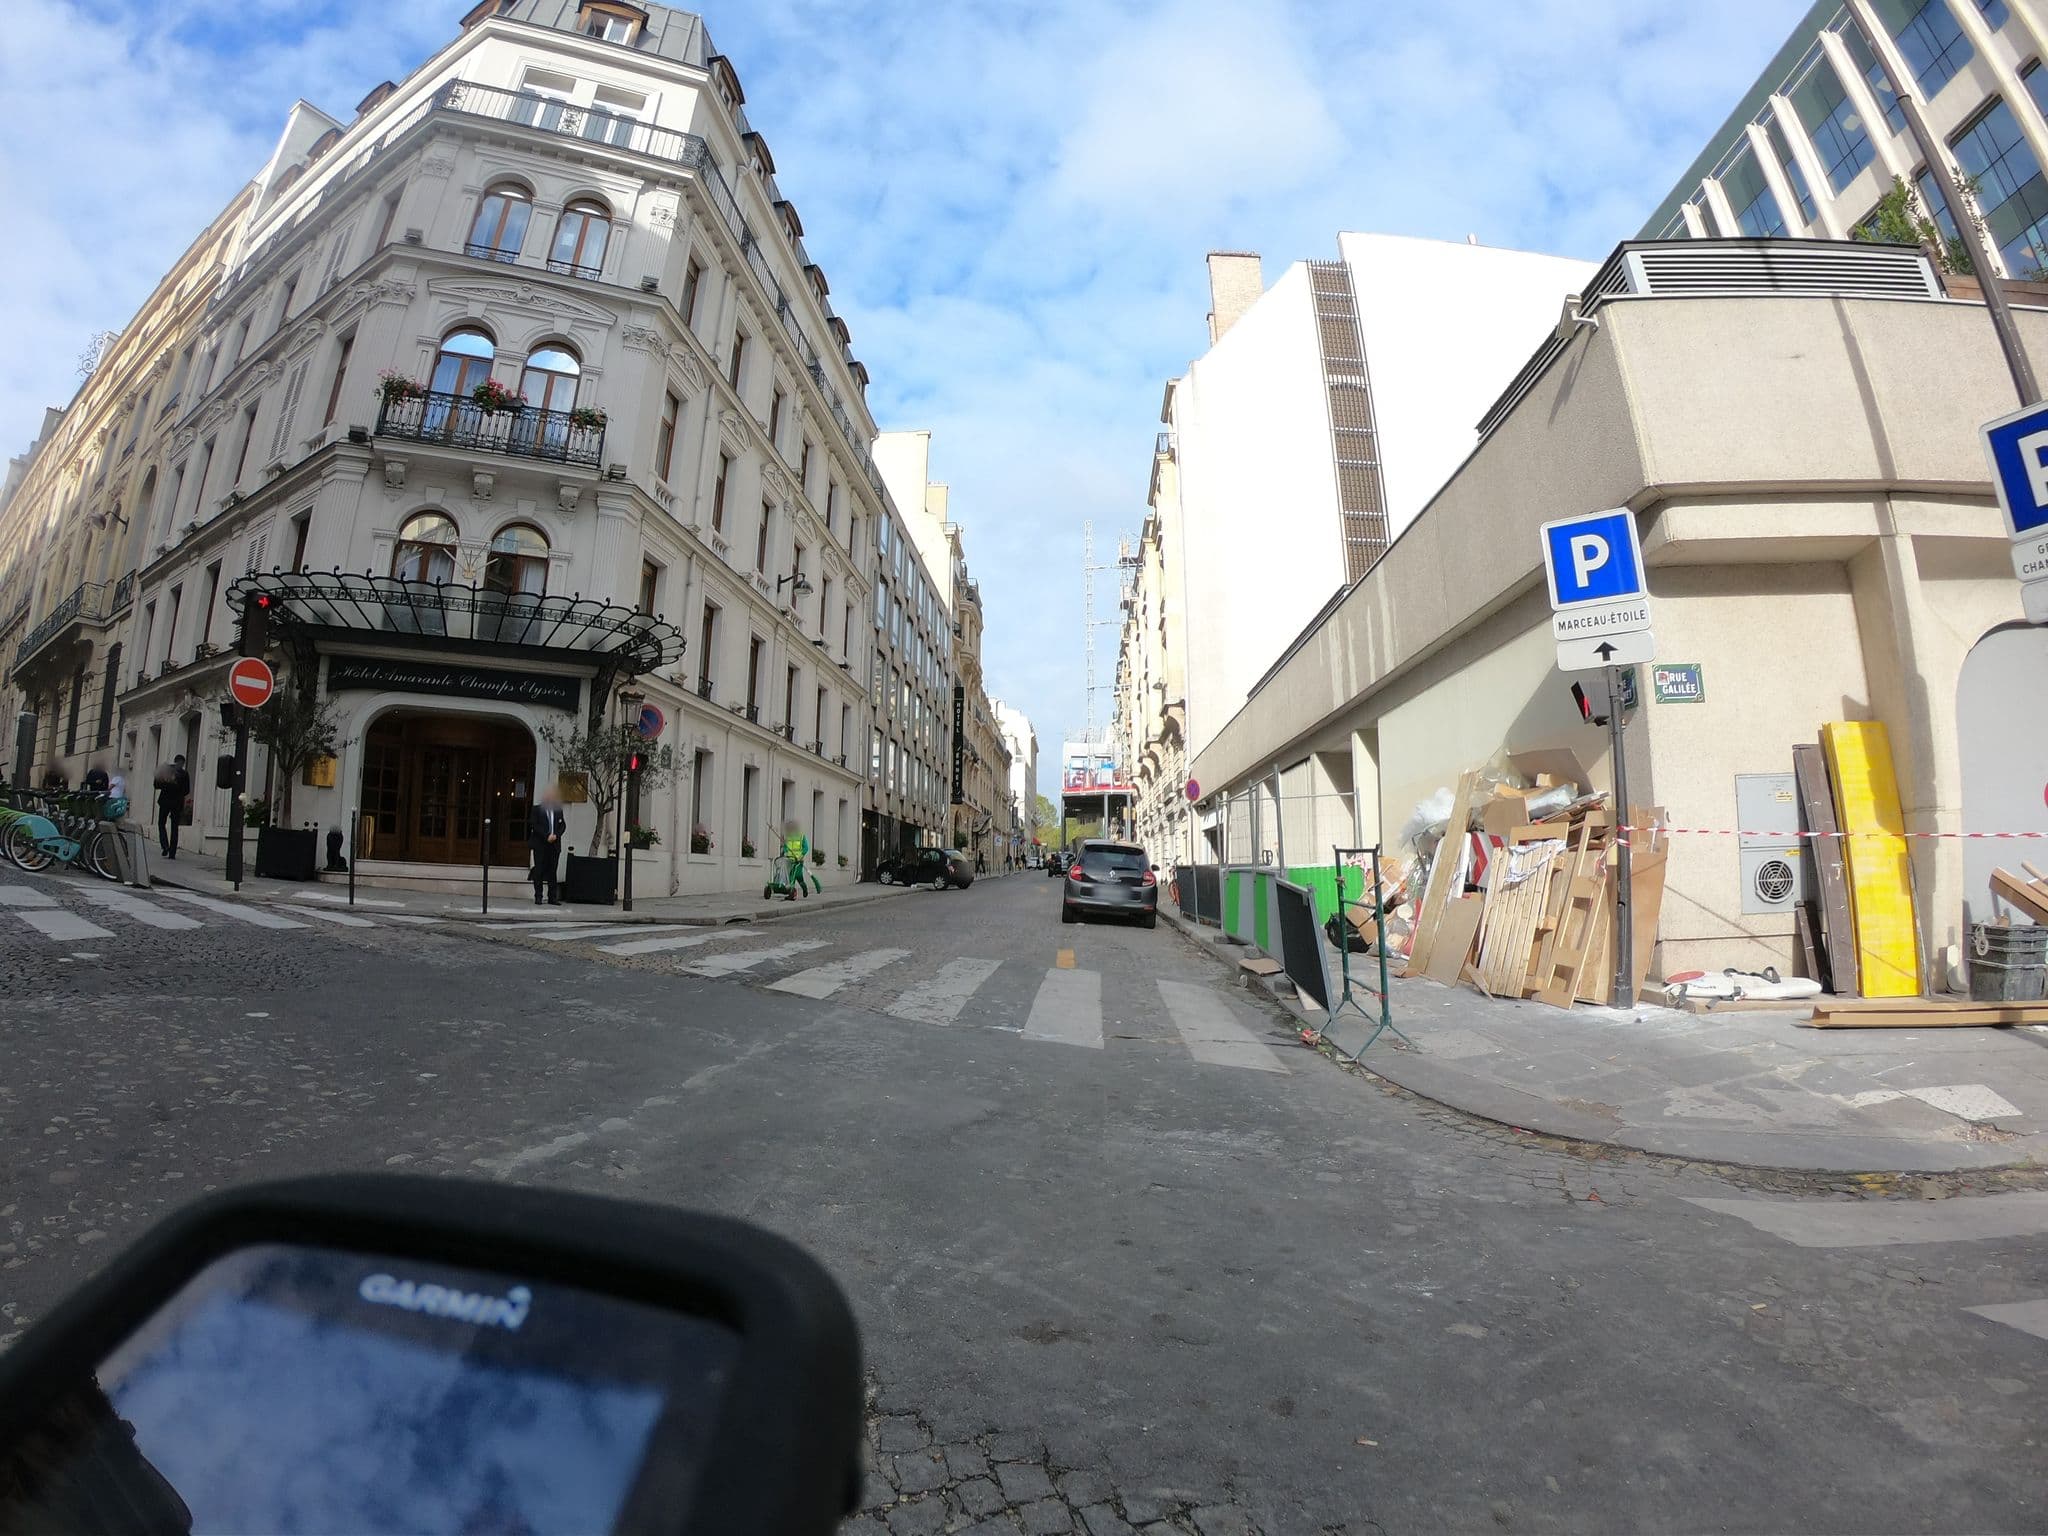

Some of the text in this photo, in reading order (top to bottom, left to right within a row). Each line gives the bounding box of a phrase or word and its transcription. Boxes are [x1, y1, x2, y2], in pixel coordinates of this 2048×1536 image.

[2017, 430, 2048, 508] P
[1570, 534, 1610, 588] P
[1558, 609, 1646, 632] MARCEAU-ÉTOILE
[459, 673, 514, 696] Champs
[1662, 682, 1697, 694] GALILÉE
[1669, 672, 1688, 682] RUE
[359, 1273, 532, 1330] GARMIN
